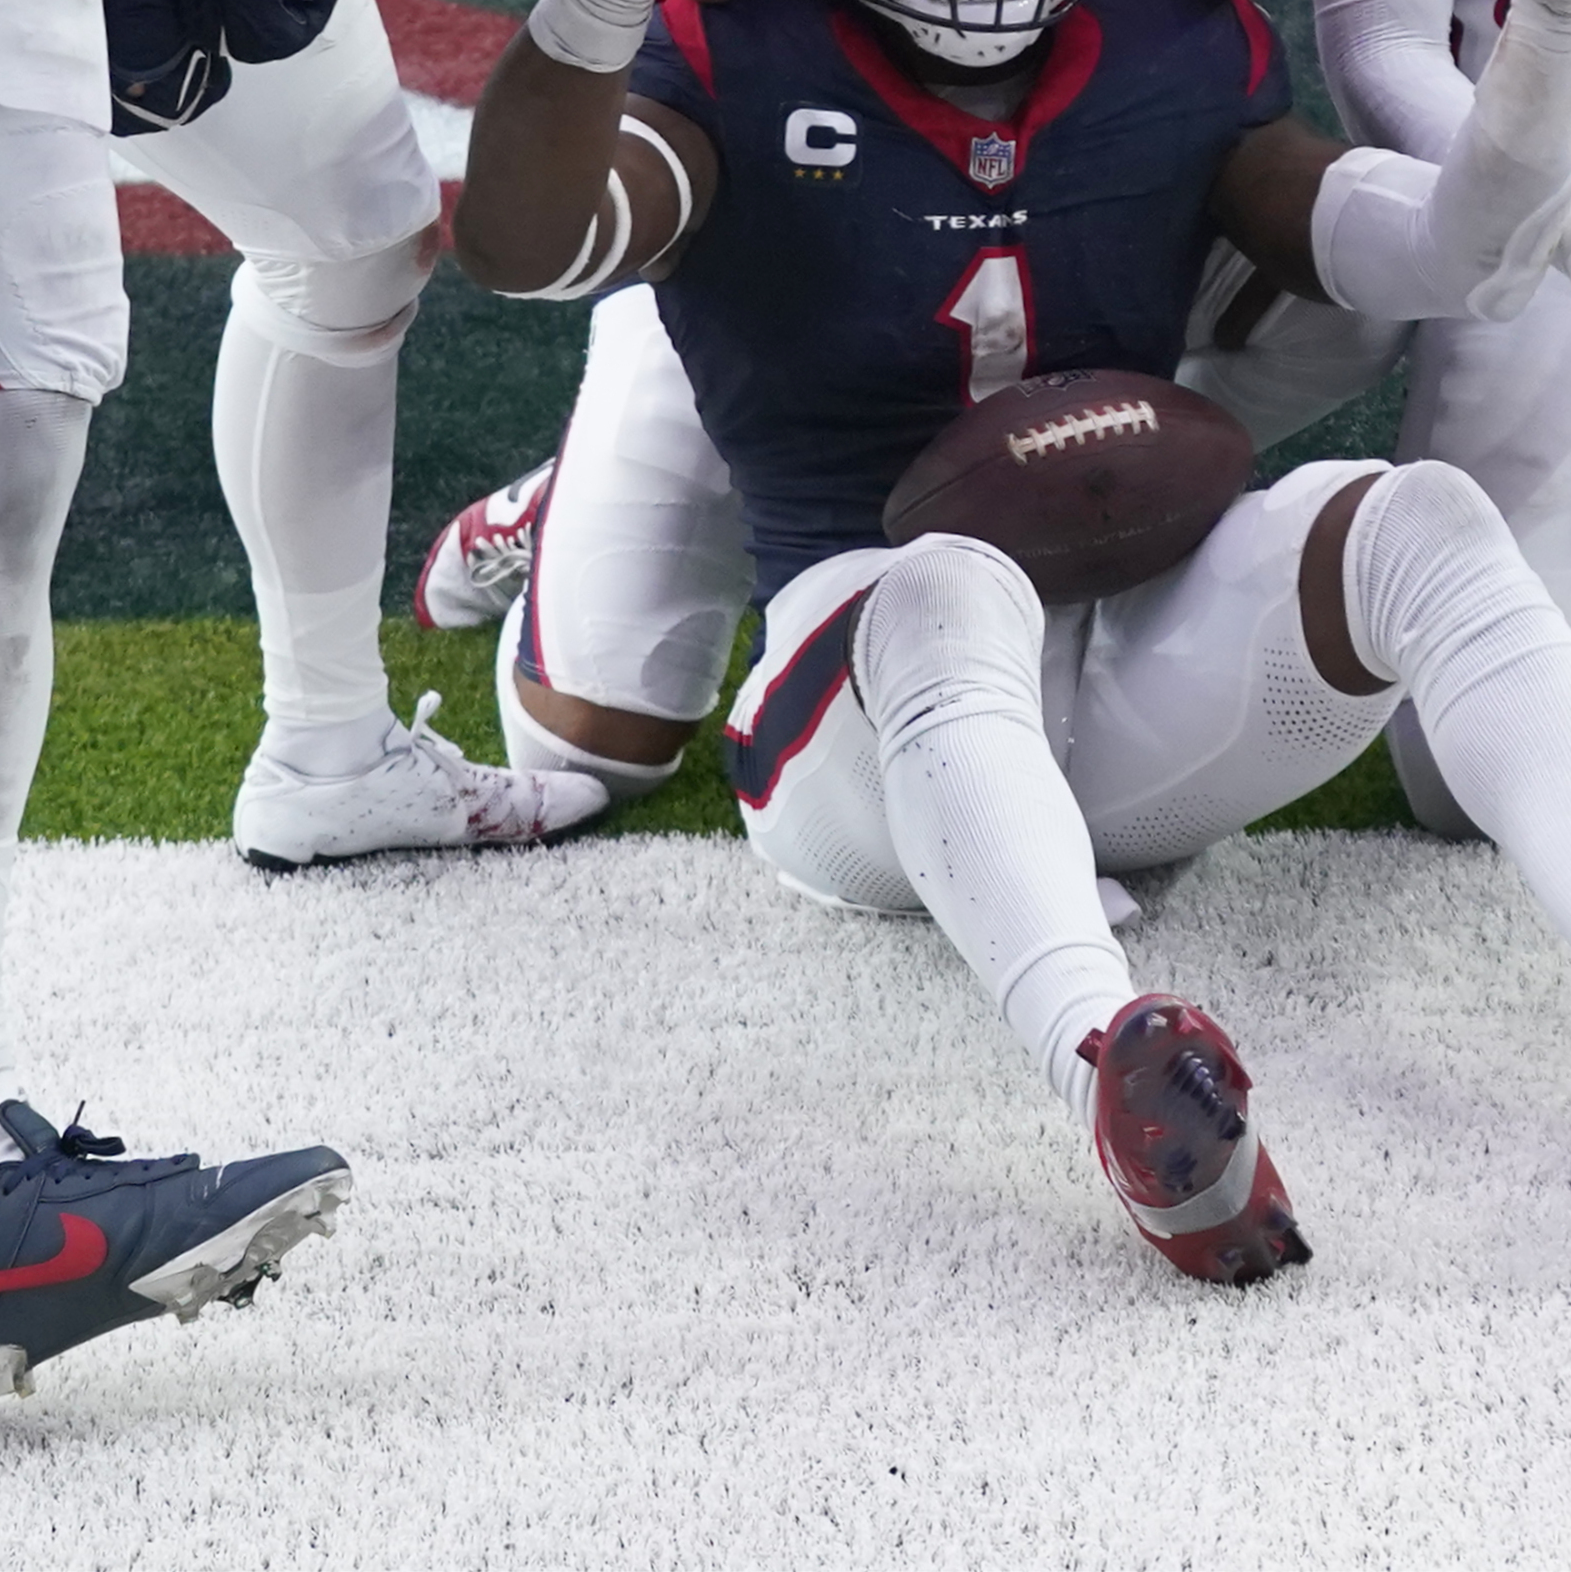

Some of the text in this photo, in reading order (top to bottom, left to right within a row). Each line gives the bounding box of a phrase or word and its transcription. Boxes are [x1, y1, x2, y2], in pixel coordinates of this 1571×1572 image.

[784, 107, 858, 168] C
[976, 158, 1006, 178] NFL
[924, 209, 1029, 231] TEXANS
[932, 244, 1038, 408] 1
